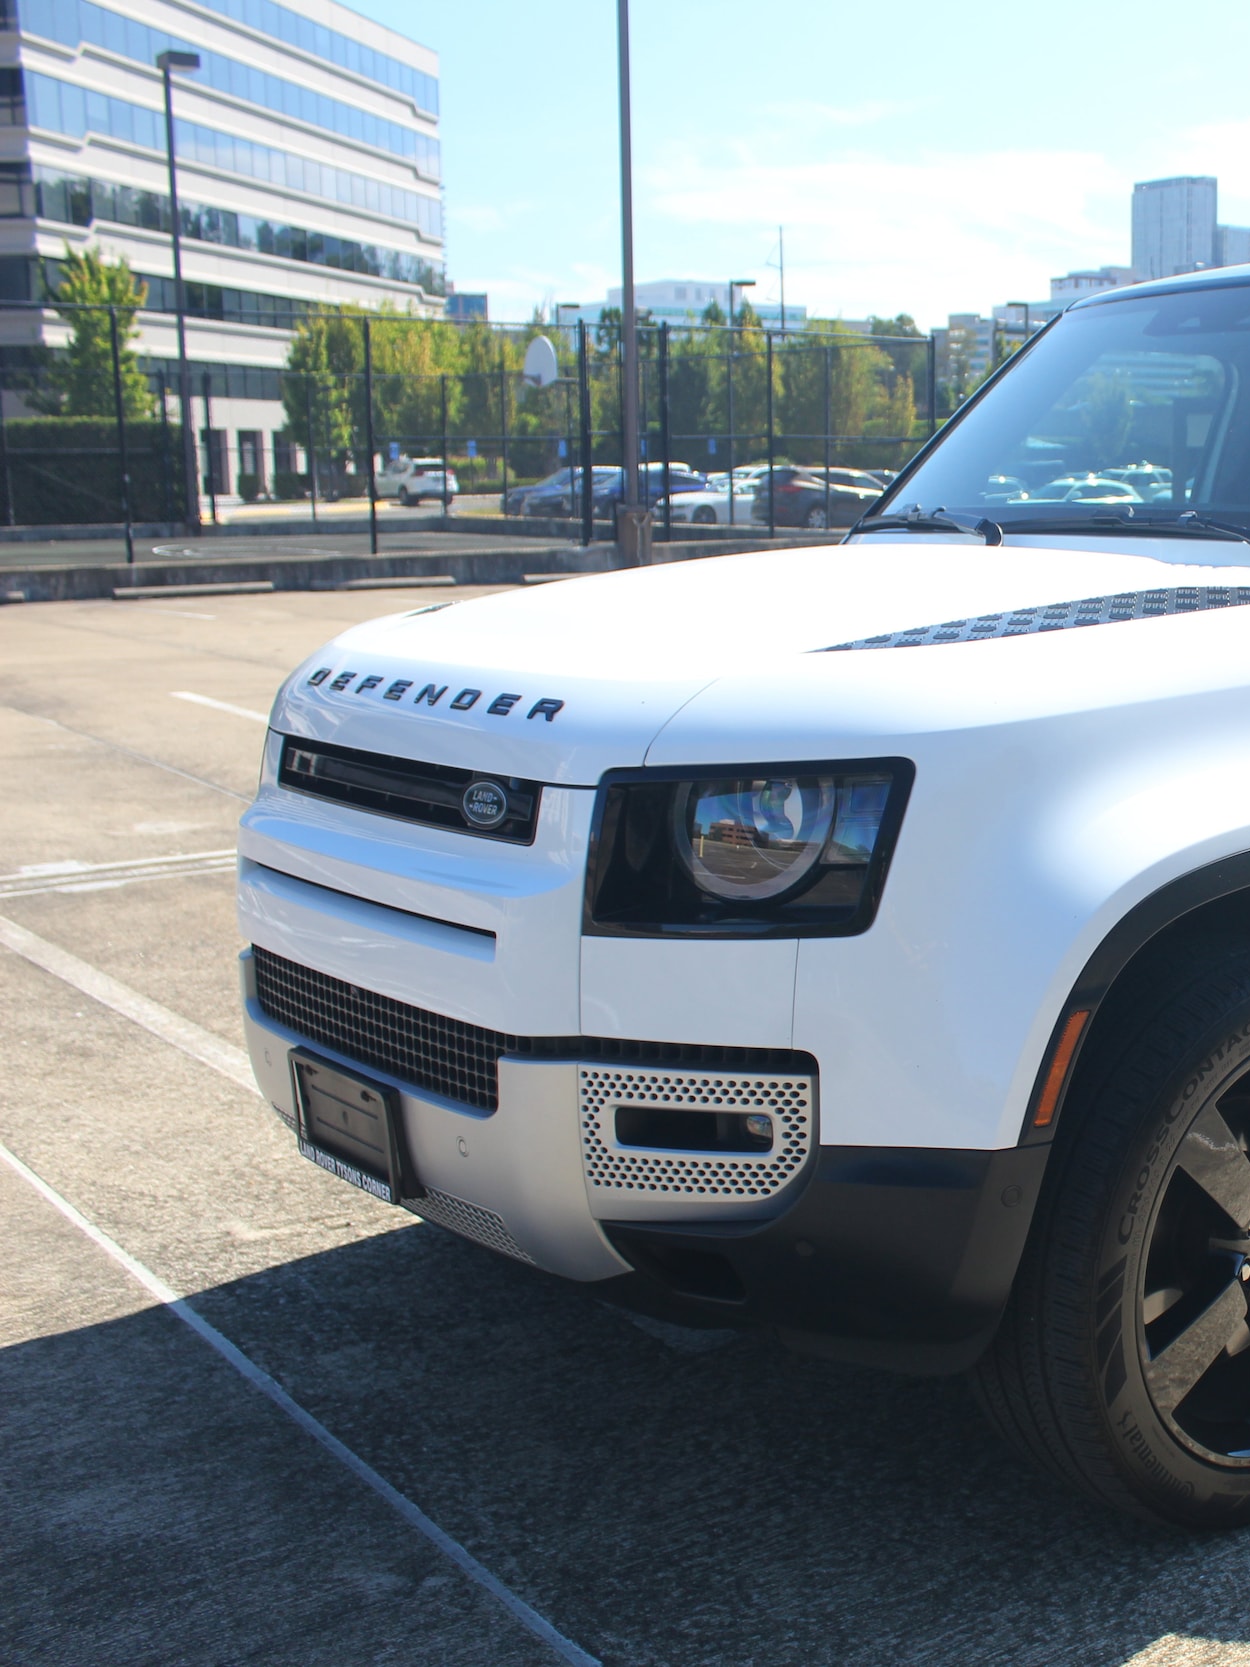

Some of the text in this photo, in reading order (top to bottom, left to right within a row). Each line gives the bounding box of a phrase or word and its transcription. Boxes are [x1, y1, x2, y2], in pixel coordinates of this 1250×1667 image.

[307, 667, 566, 722] DEFENDER
[301, 1139, 392, 1202] LAND ROVER TYSONS CORNER
